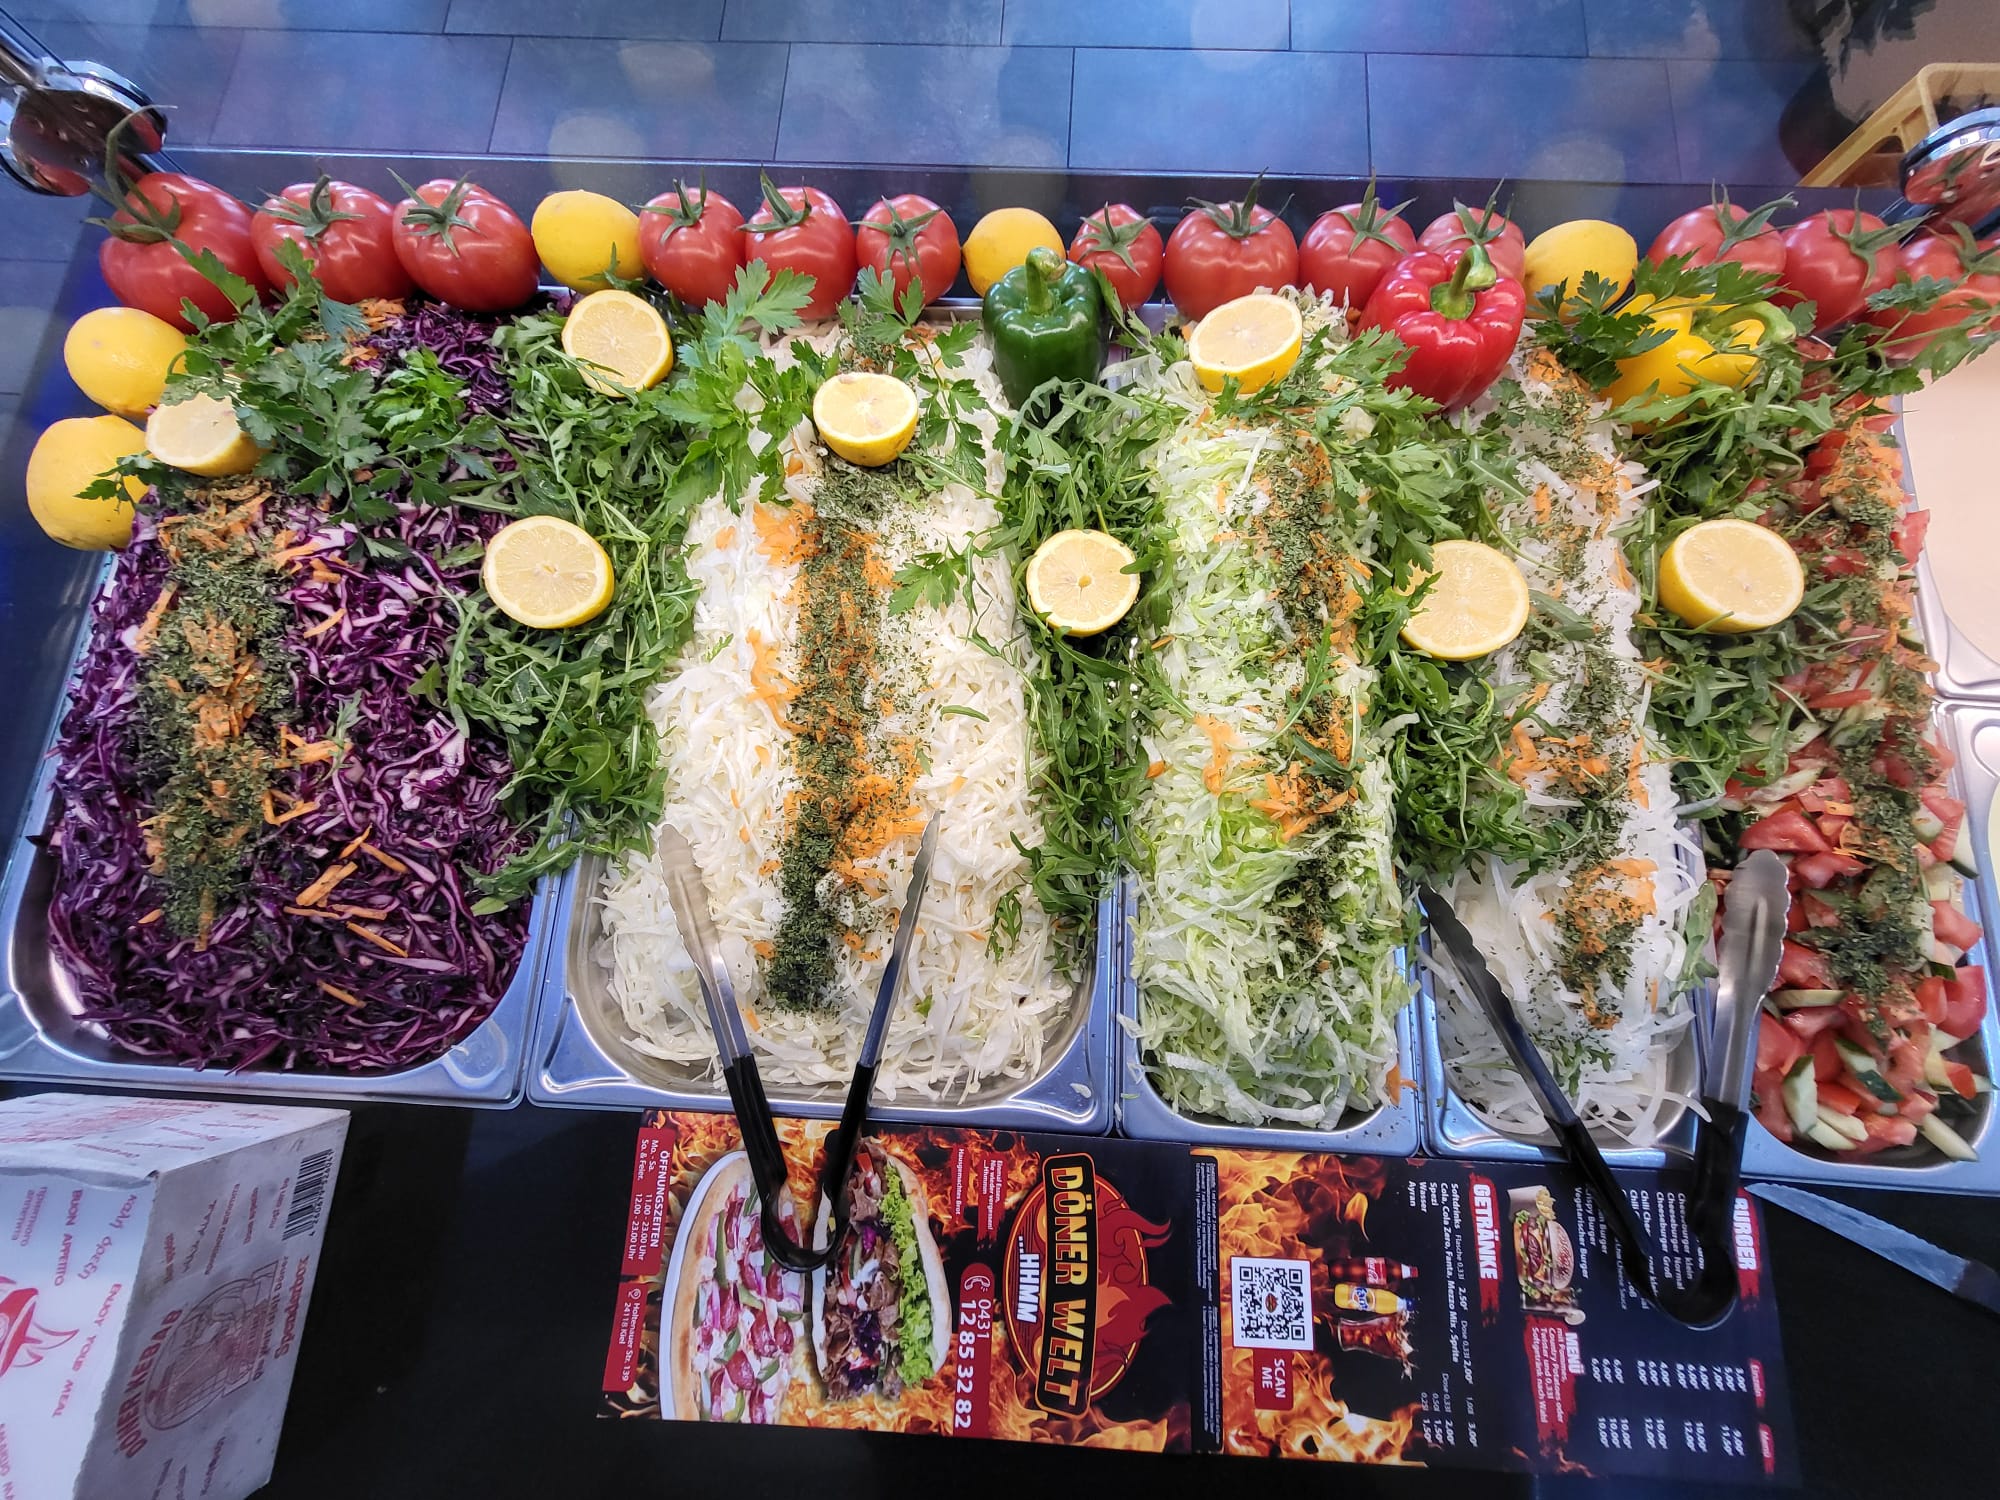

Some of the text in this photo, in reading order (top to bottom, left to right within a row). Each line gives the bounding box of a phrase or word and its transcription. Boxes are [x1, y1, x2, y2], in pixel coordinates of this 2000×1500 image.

[640, 1139, 650, 1151] So.
[649, 1140, 659, 1154] Mo.
[648, 1160, 657, 1172] Sa.
[956, 1148, 965, 1200] Hausgemachtes
[988, 1172, 996, 1194] wieder
[1407, 1180, 1417, 1207] Ayran
[1419, 1181, 1428, 1213] Wasser
[1440, 1182, 1449, 1205] Cola,
[633, 1193, 644, 1215] 12.00
[643, 1194, 653, 1215] 11.00
[650, 1150, 671, 1248] ÖFFNUNGSZEITEN
[1450, 1183, 1461, 1229] Softdrinks
[1585, 1189, 1595, 1215] rispy
[1629, 1189, 1639, 1210] Chili
[1640, 1190, 1649, 1210] Chili
[1441, 1205, 1451, 1226] Cola
[1574, 1187, 1586, 1246] Vegetarischer
[1587, 1215, 1597, 1246] Burger
[54, 1189, 83, 1286] BUON APPETITO
[631, 1221, 641, 1243] 23.00
[641, 1221, 651, 1242] 23.00
[1443, 1226, 1451, 1250] Zero,
[1454, 1234, 1463, 1260] Flasche
[1472, 1183, 1500, 1280] GETRÄNKE
[1598, 1223, 1608, 1255] Burger
[1656, 1191, 1668, 1253] Cheeseburger
[1662, 1255, 1673, 1278] Groß
[1667, 1192, 1680, 1253] Cheeseburger
[1674, 1256, 1685, 1290] Normal
[1733, 1197, 1757, 1270] BURGER
[628, 1244, 638, 1260] Uhr
[638, 1244, 648, 1261] Uhr
[1445, 1251, 1454, 1279] Fanta,
[1579, 1247, 1589, 1279] Burger
[1684, 1256, 1693, 1280] klein
[1043, 1166, 1093, 1407] DÖNER WELT
[1428, 1181, 1439, 1206] Spezi
[1442, 1373, 1450, 1393] Dose
[1447, 1280, 1455, 1310] Mezzo
[94, 1283, 122, 1326] ENJOY
[274, 1254, 310, 1360] Spenderbox
[976, 1298, 991, 1339] 0431
[1449, 1311, 1458, 1329] Mix
[618, 1302, 632, 1345] 24118 Kiel
[1460, 1320, 1468, 1339] Dose
[621, 1302, 641, 1381] Holtenauer Str. 139
[1450, 1334, 1459, 1363] Sprite
[1565, 1332, 1586, 1375] MENÜ
[954, 1299, 976, 1429] 12 85 32 82
[1261, 1366, 1273, 1389] ME
[1273, 1358, 1286, 1399] SCAN
[1549, 1327, 1557, 1362] Country
[1556, 1402, 1564, 1423] oder
[52, 1379, 75, 1418] MEAL
[113, 1309, 184, 1459] DÖNER KEBAB
